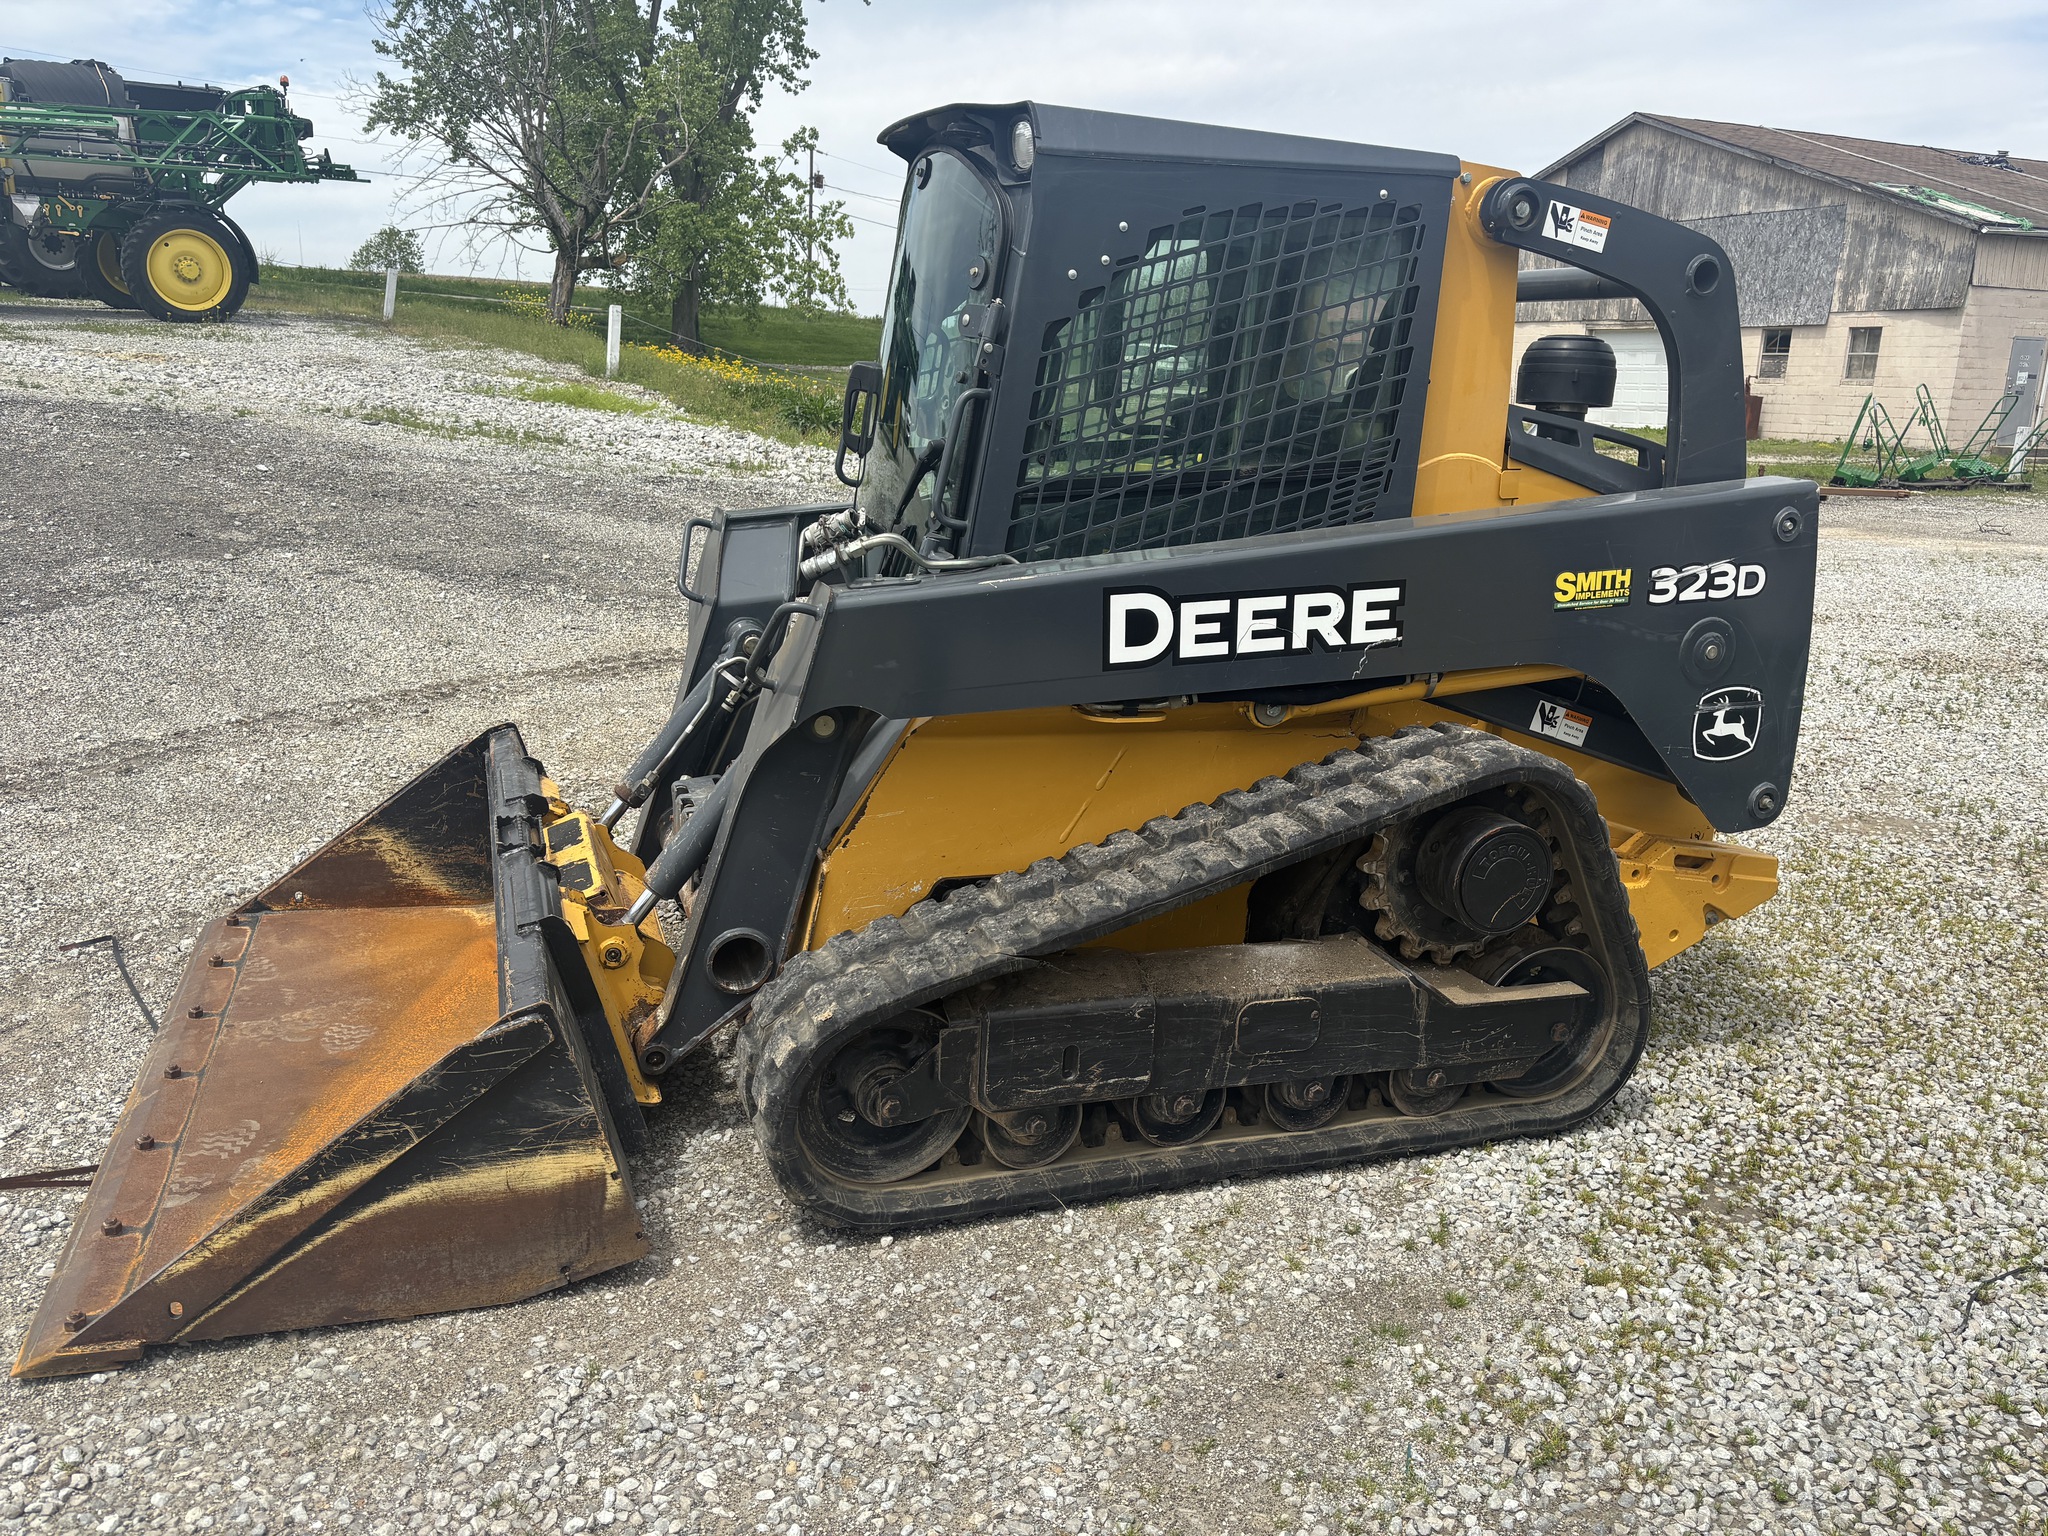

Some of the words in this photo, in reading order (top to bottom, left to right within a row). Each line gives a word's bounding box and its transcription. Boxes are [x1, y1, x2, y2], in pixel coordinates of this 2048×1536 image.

[1585, 215, 1608, 226] WARNING
[1580, 226, 1593, 235] Pinch
[1593, 230, 1603, 238] Area
[1554, 568, 1632, 602] SMITH
[1648, 563, 1766, 604] 323D
[1575, 588, 1630, 601] IMPLEMENTS
[1109, 587, 1400, 664] DEERE
[1569, 713, 1589, 724] WARNING
[1564, 723, 1575, 731] Pinch
